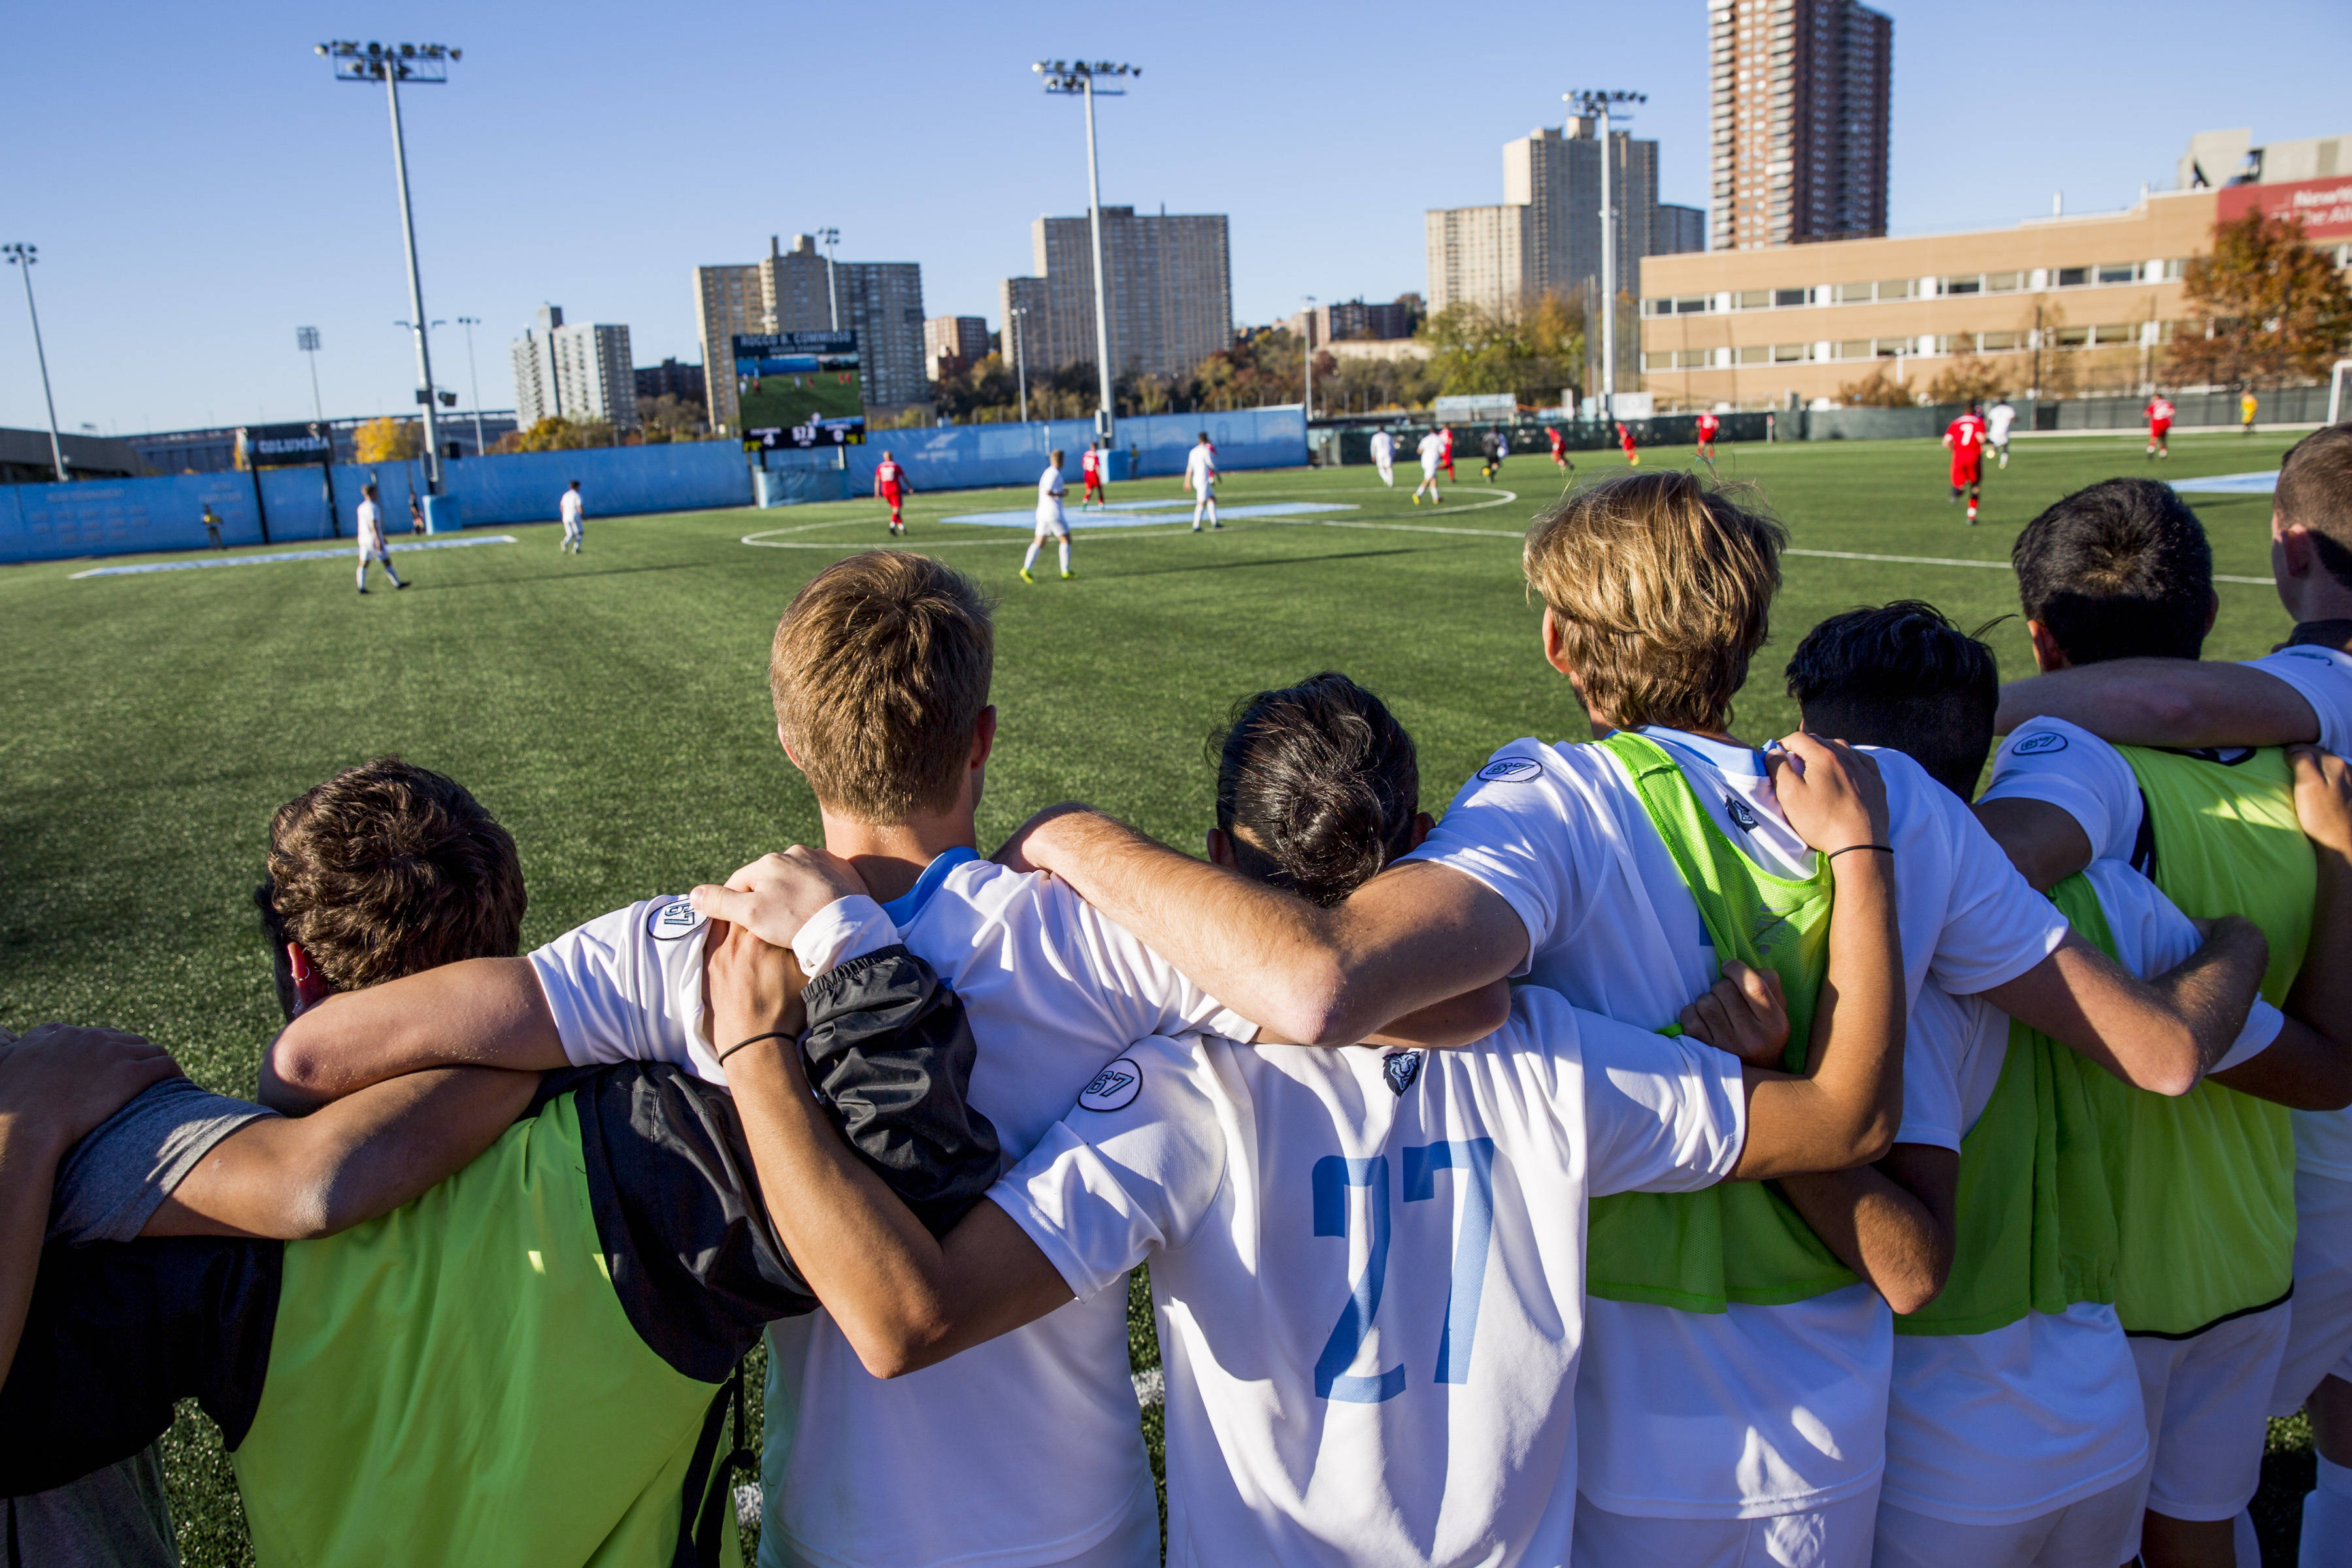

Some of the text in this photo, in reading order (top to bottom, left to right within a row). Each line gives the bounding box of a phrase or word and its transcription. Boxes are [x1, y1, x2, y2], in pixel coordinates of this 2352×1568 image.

[258, 436, 330, 453] COLUMBIA
[1960, 423, 1974, 446] 7
[1485, 762, 1534, 776] 67
[664, 902, 695, 925] 67
[1086, 1071, 1135, 1097] 67
[1312, 1137, 1494, 1404] 27
